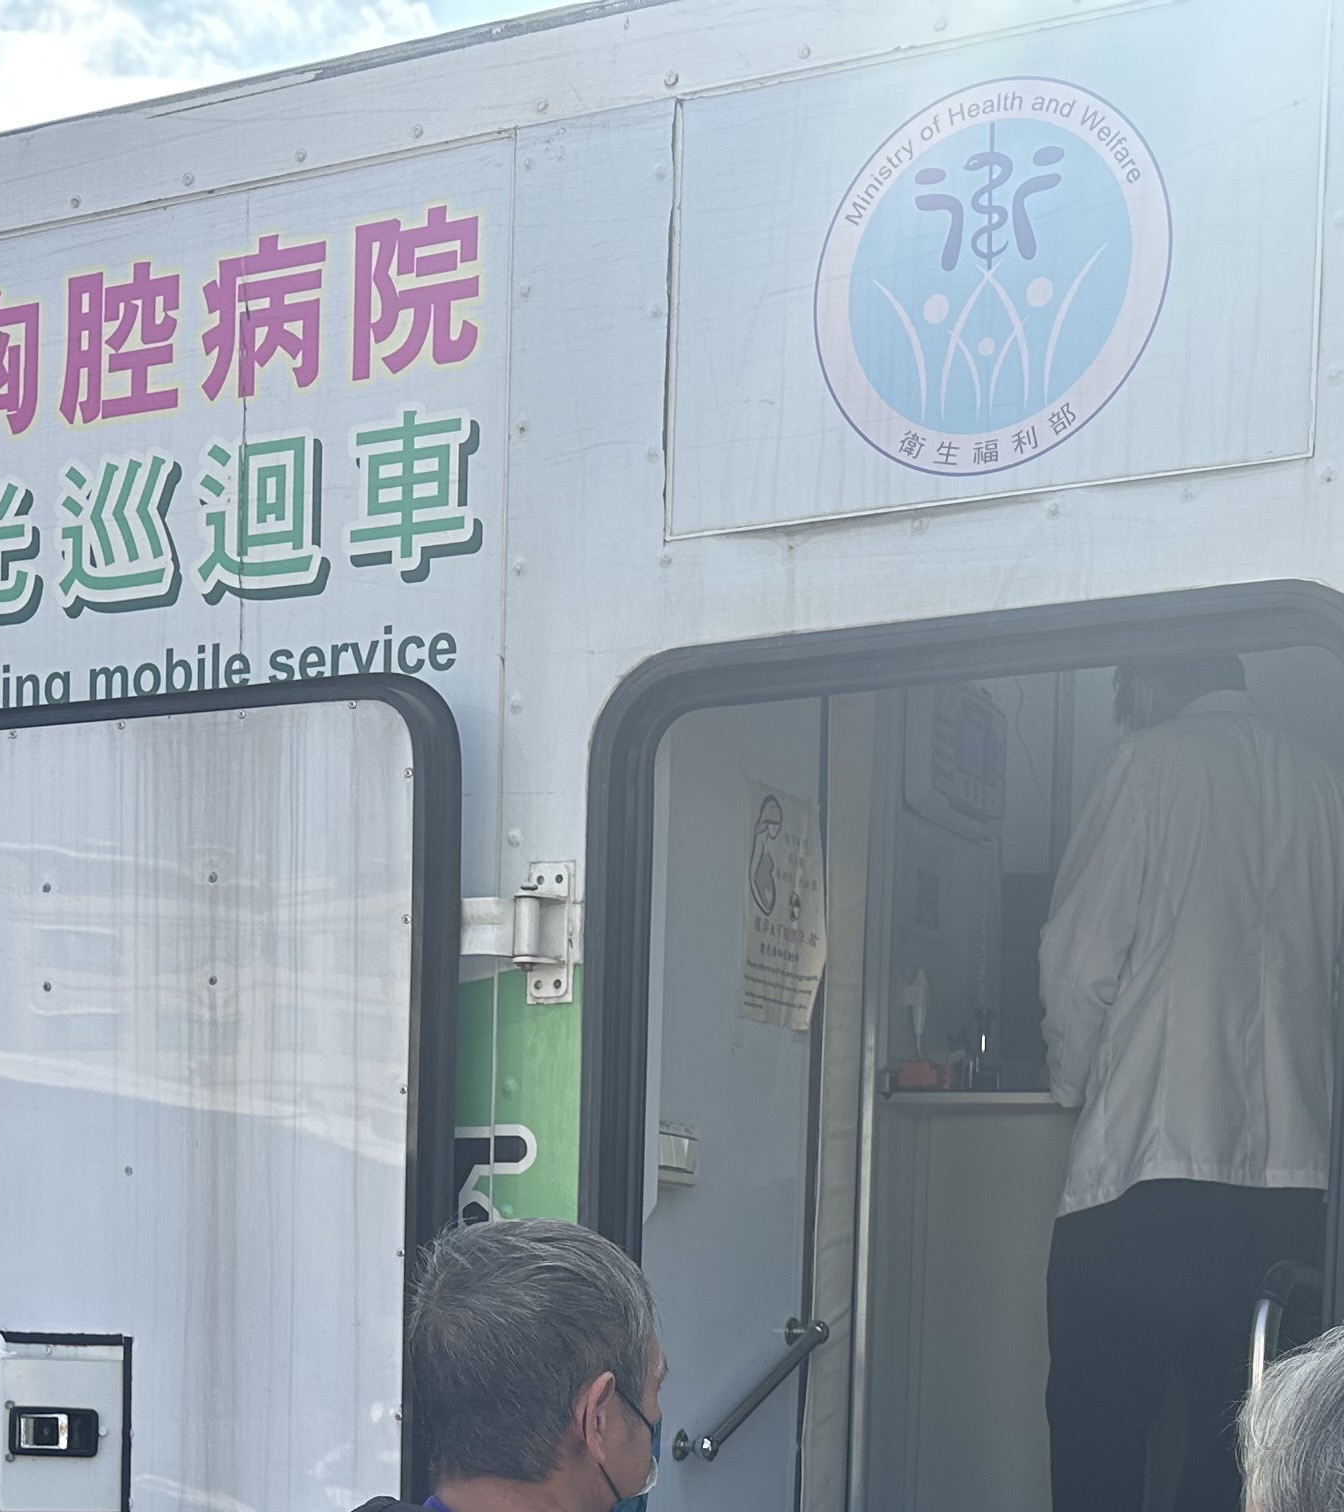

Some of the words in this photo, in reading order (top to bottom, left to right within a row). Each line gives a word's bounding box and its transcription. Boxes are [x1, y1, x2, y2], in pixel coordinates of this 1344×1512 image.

[845, 140, 913, 226] Ministry
[920, 116, 942, 142] of
[947, 91, 1024, 127] Health
[1031, 96, 1077, 119] and
[1079, 105, 1143, 184] Welfare
[898, 402, 1077, 466] 衛生福利部
[89, 645, 252, 701] mobile
[268, 625, 459, 682] service
